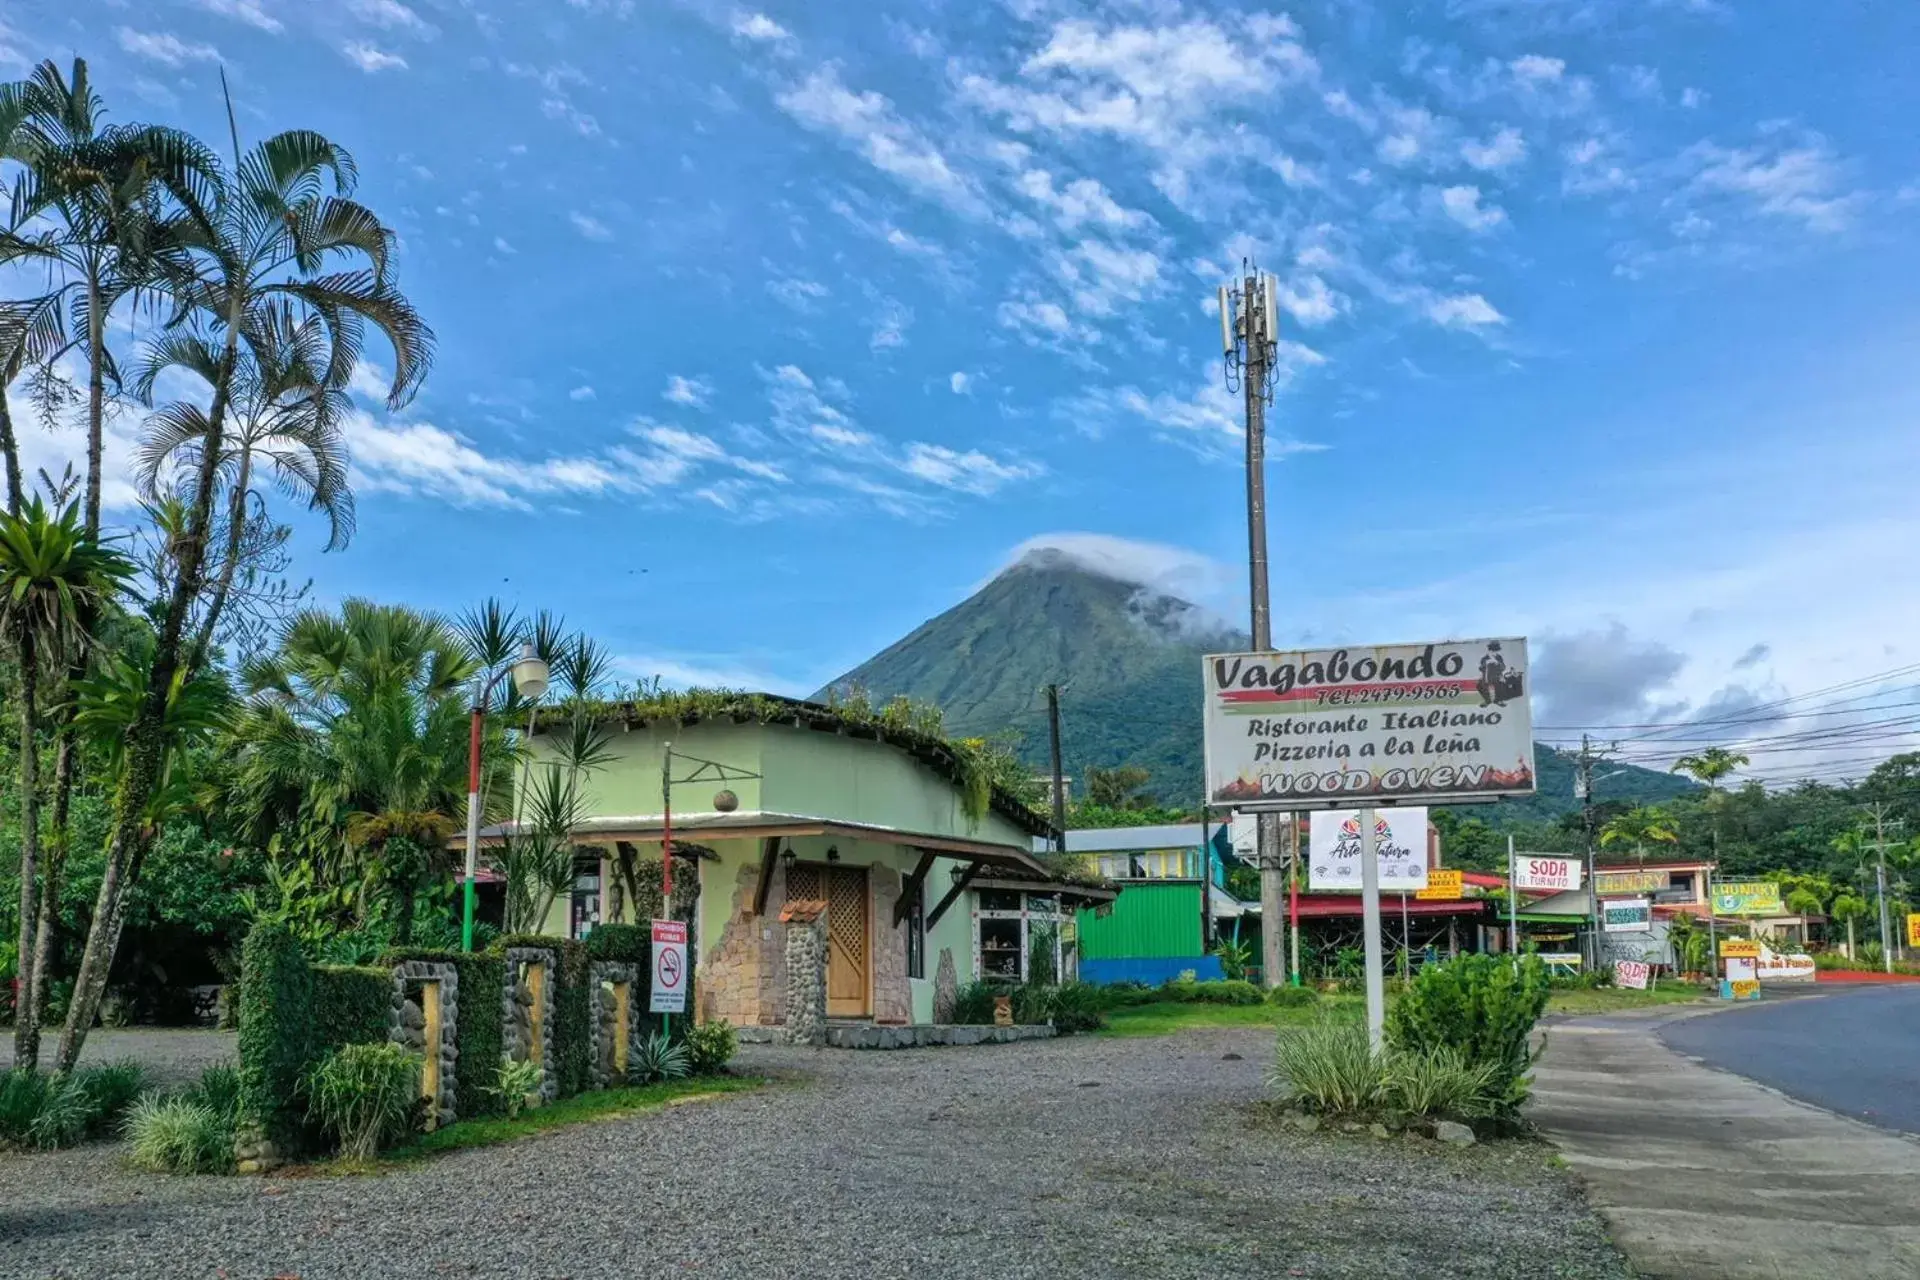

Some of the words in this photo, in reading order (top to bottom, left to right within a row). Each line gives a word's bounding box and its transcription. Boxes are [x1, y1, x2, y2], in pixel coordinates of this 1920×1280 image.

[1215, 645, 1463, 696] Vagabondo
[1247, 714, 1368, 738] Ristorante
[1380, 709, 1502, 731] Italiano
[1253, 740, 1350, 761] Pizzeria
[1359, 743, 1375, 757] a
[1384, 737, 1414, 756] la
[1423, 733, 1481, 754] Leña
[1260, 769, 1372, 794] WOOD
[1329, 840, 1361, 859] Arte
[1530, 860, 1567, 876] SODA
[1616, 961, 1647, 978] SODA
